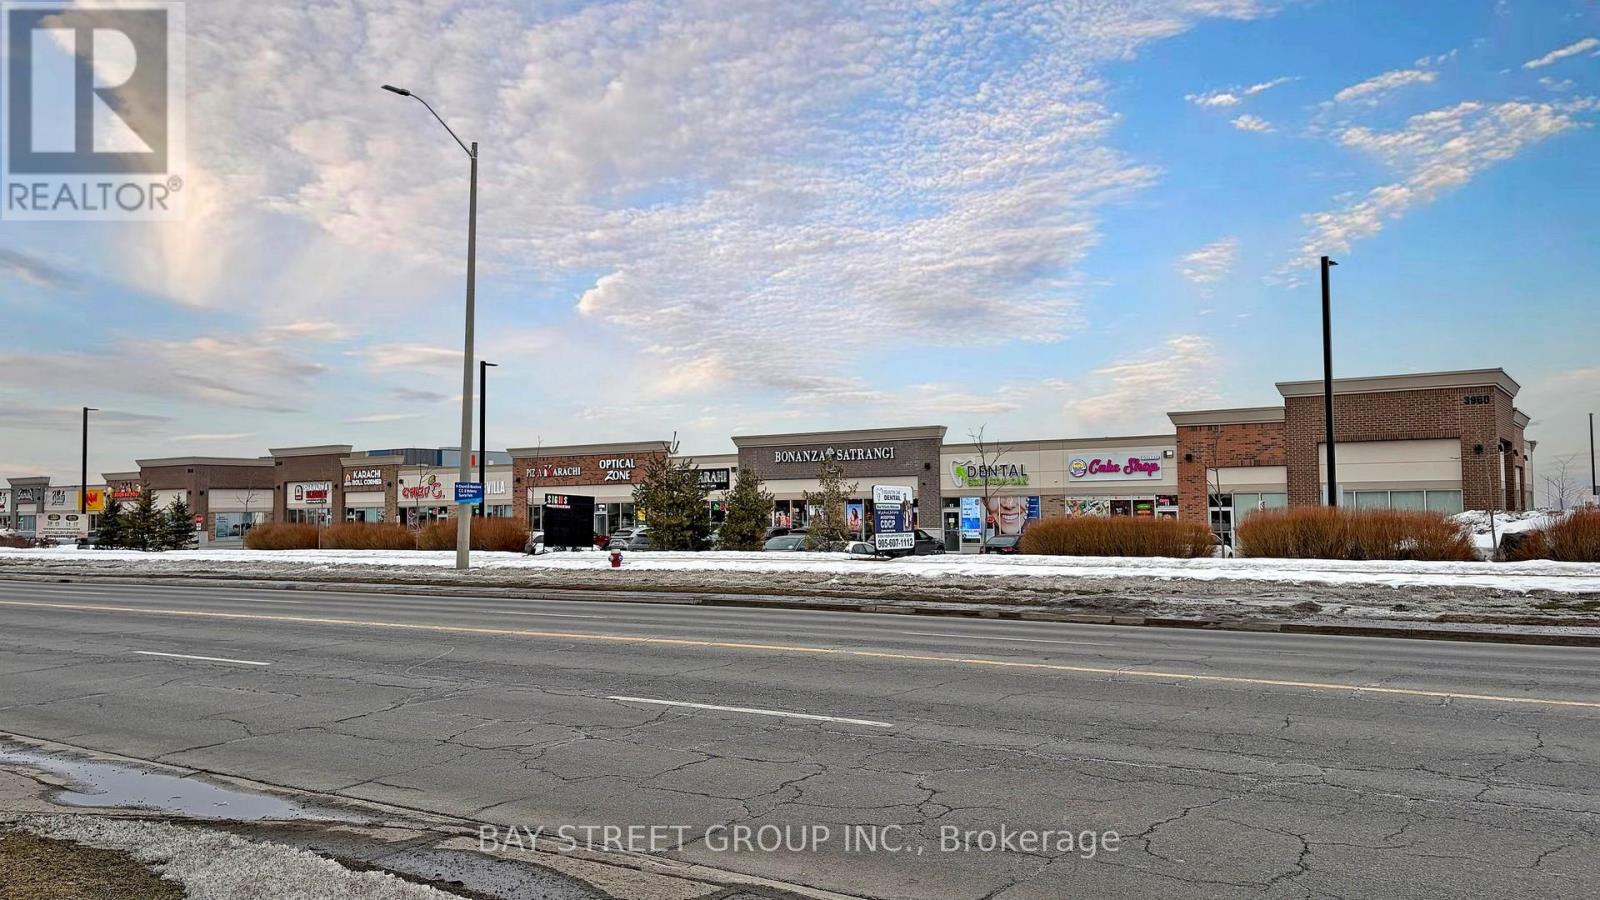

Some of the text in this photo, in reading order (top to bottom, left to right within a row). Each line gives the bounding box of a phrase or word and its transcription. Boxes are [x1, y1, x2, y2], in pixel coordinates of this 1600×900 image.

[775, 447, 895, 463] BONANZA SATRANGI
[599, 458, 636, 470] OPTICAL
[1088, 457, 1161, 477] Cake Shop
[353, 469, 381, 479] KARACHI
[604, 470, 632, 481] ZONE
[699, 470, 728, 483] ARAHI
[967, 464, 1029, 478] DENTAL
[486, 480, 506, 494] VILLA
[880, 520, 896, 529] CDCP
